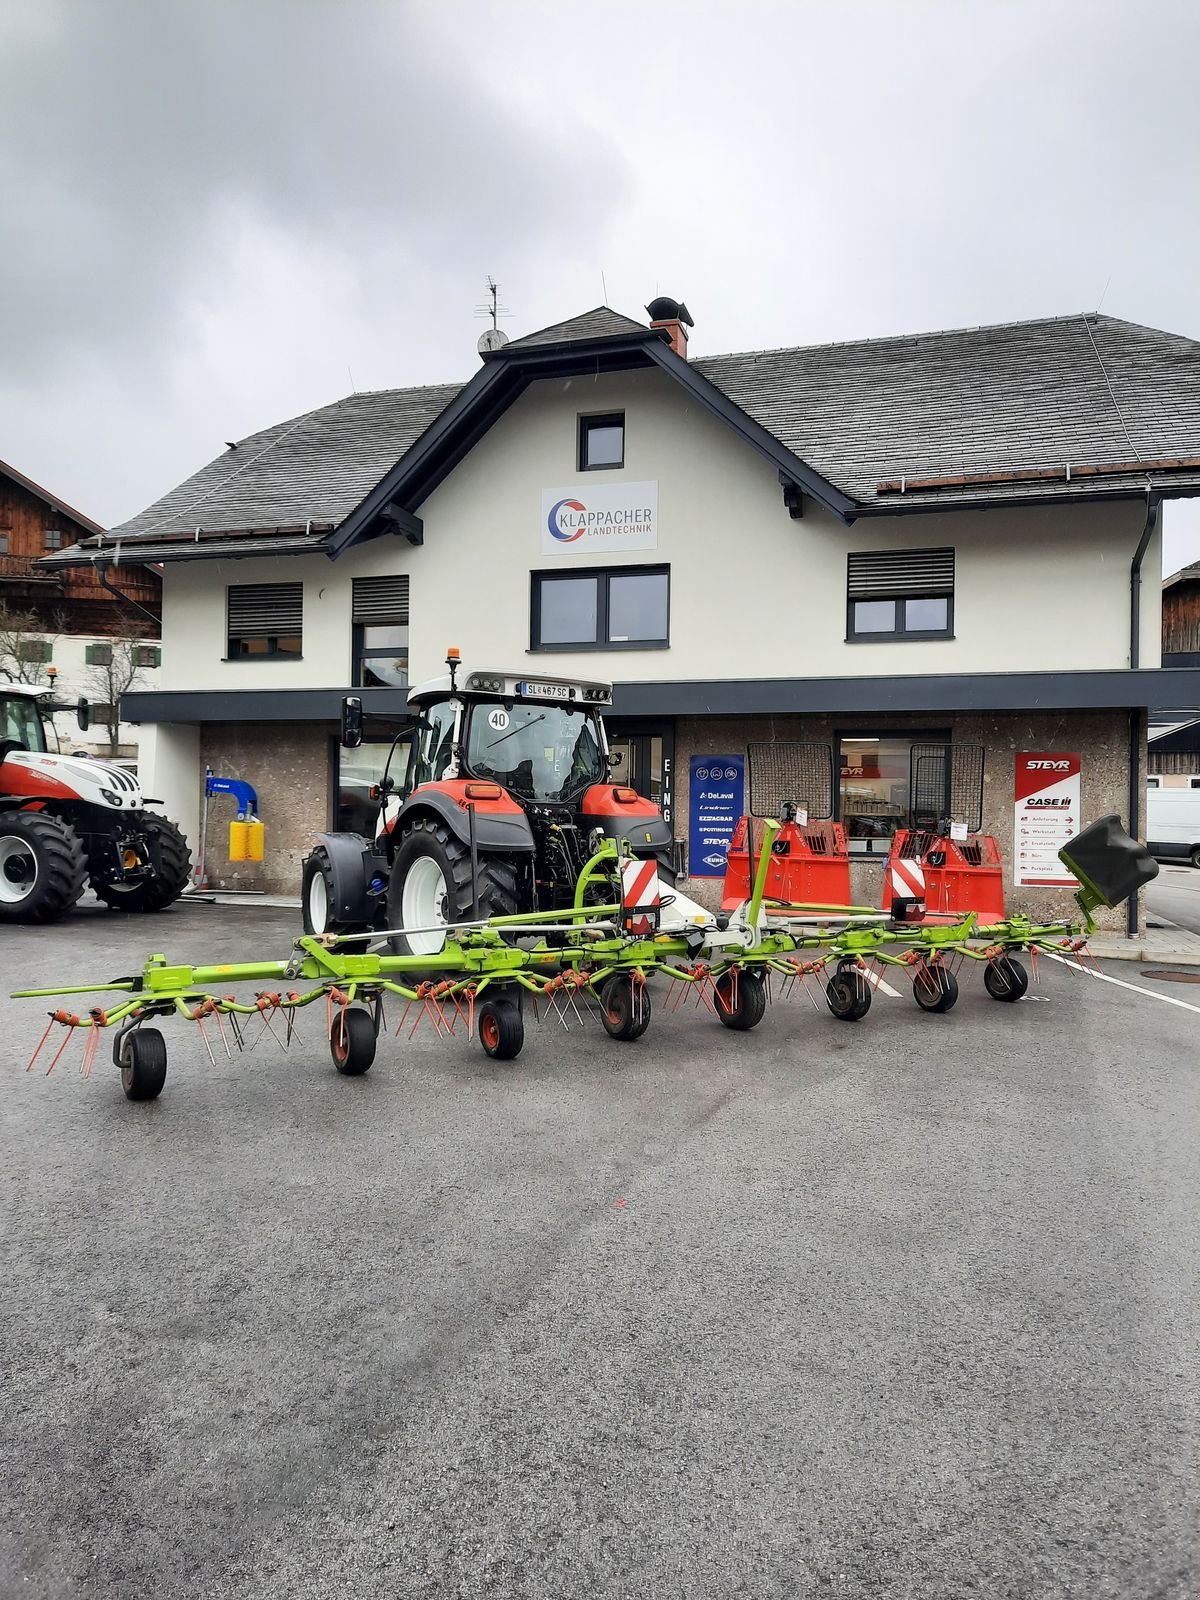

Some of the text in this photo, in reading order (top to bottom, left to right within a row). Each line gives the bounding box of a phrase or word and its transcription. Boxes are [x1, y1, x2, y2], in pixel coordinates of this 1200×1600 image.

[560, 508, 652, 527] KLAPPACHER
[587, 524, 652, 536] LANDTECHNIK
[528, 685, 567, 697] SL 467 SC
[491, 713, 505, 727] 40
[1026, 760, 1070, 770] STEYR
[1027, 798, 1060, 806] CASE
